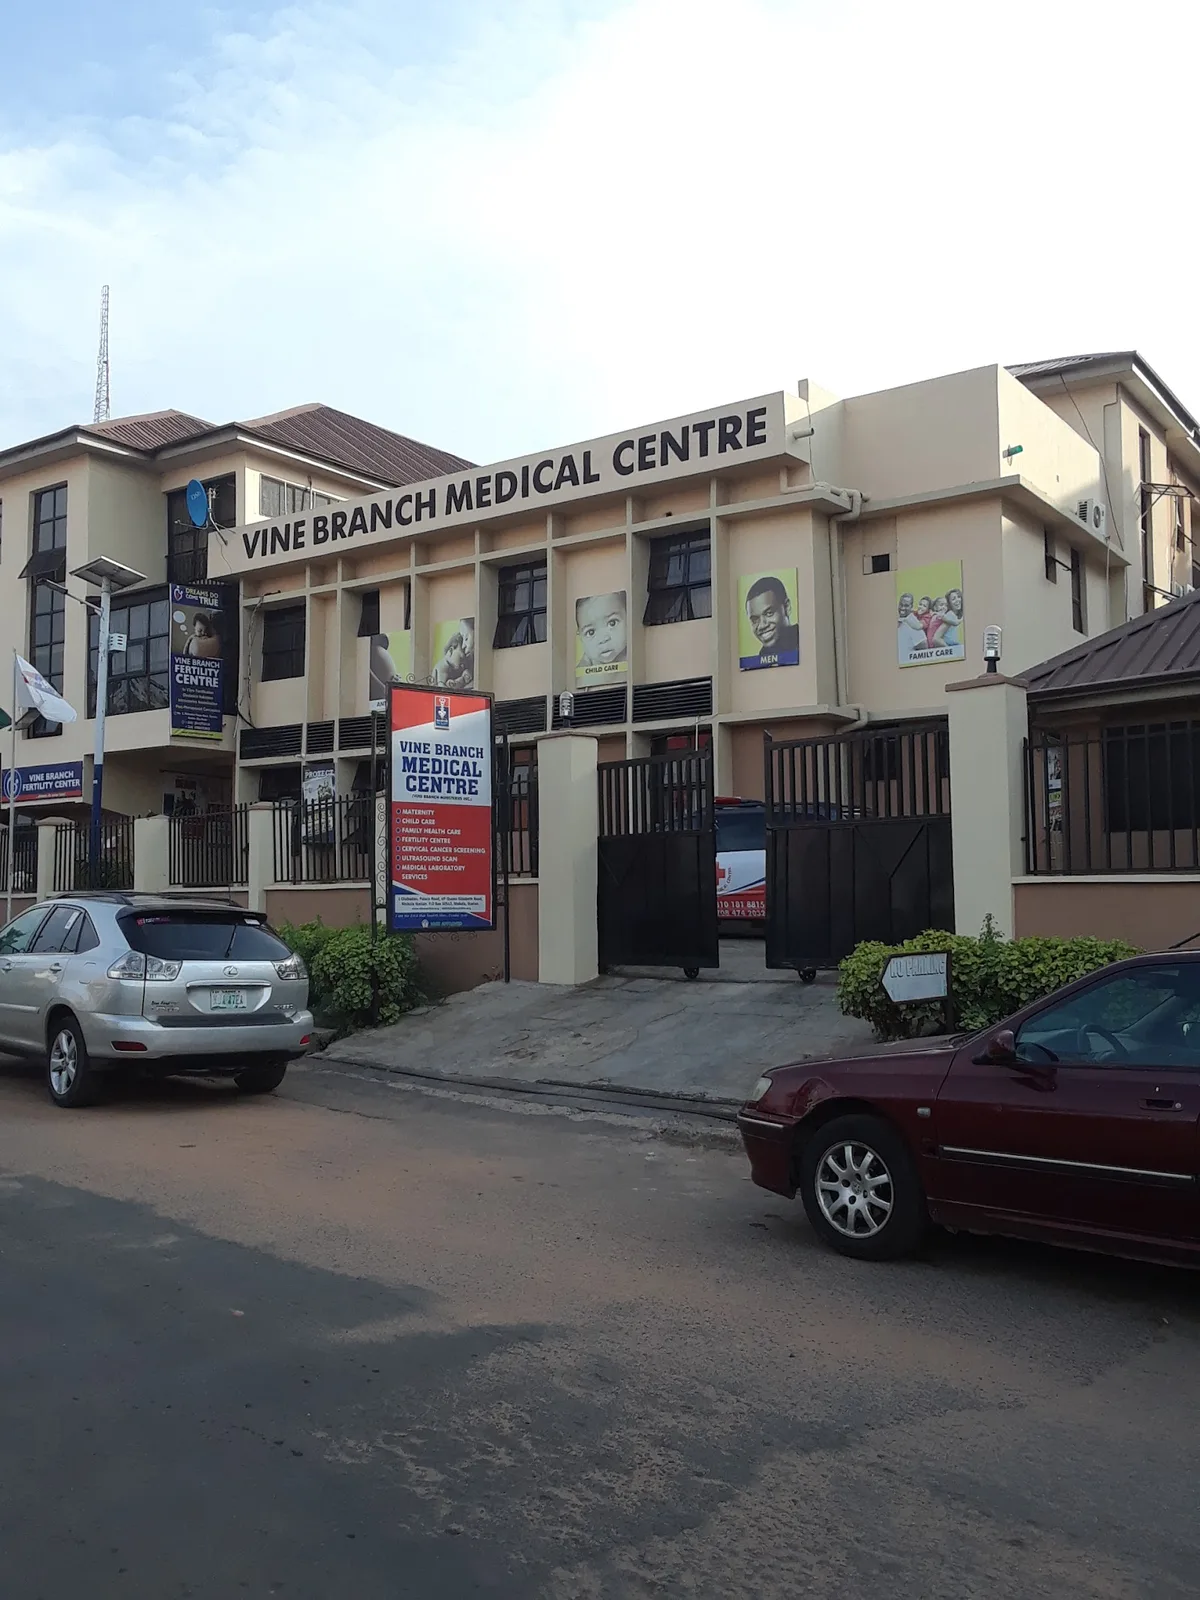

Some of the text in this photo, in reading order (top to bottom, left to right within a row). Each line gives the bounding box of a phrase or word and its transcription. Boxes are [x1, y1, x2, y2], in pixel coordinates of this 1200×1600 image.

[243, 407, 767, 559] VINE BRANCH MEDICAL CENTRE
[185, 587, 209, 597] DREAMS
[199, 596, 219, 607] TRUE
[760, 654, 778, 664] MEN
[909, 648, 953, 660] FAMILY CARE
[174, 656, 220, 669] VINE BRANCH
[174, 664, 219, 678] FERTILITY
[585, 664, 619, 674] CHILD CARE
[175, 673, 219, 688] CENTRE
[399, 741, 484, 759] VINE BRANCH
[402, 756, 482, 777] MEDICAL
[29, 770, 74, 782] VINE BRANCH
[304, 769, 335, 779] PROTECT
[22, 778, 80, 792] FERTILITY CENTER
[405, 775, 479, 795] CENTRE
[746, 901, 765, 909] 8815
[731, 909, 746, 917] 474
[747, 909, 766, 917] 2032
